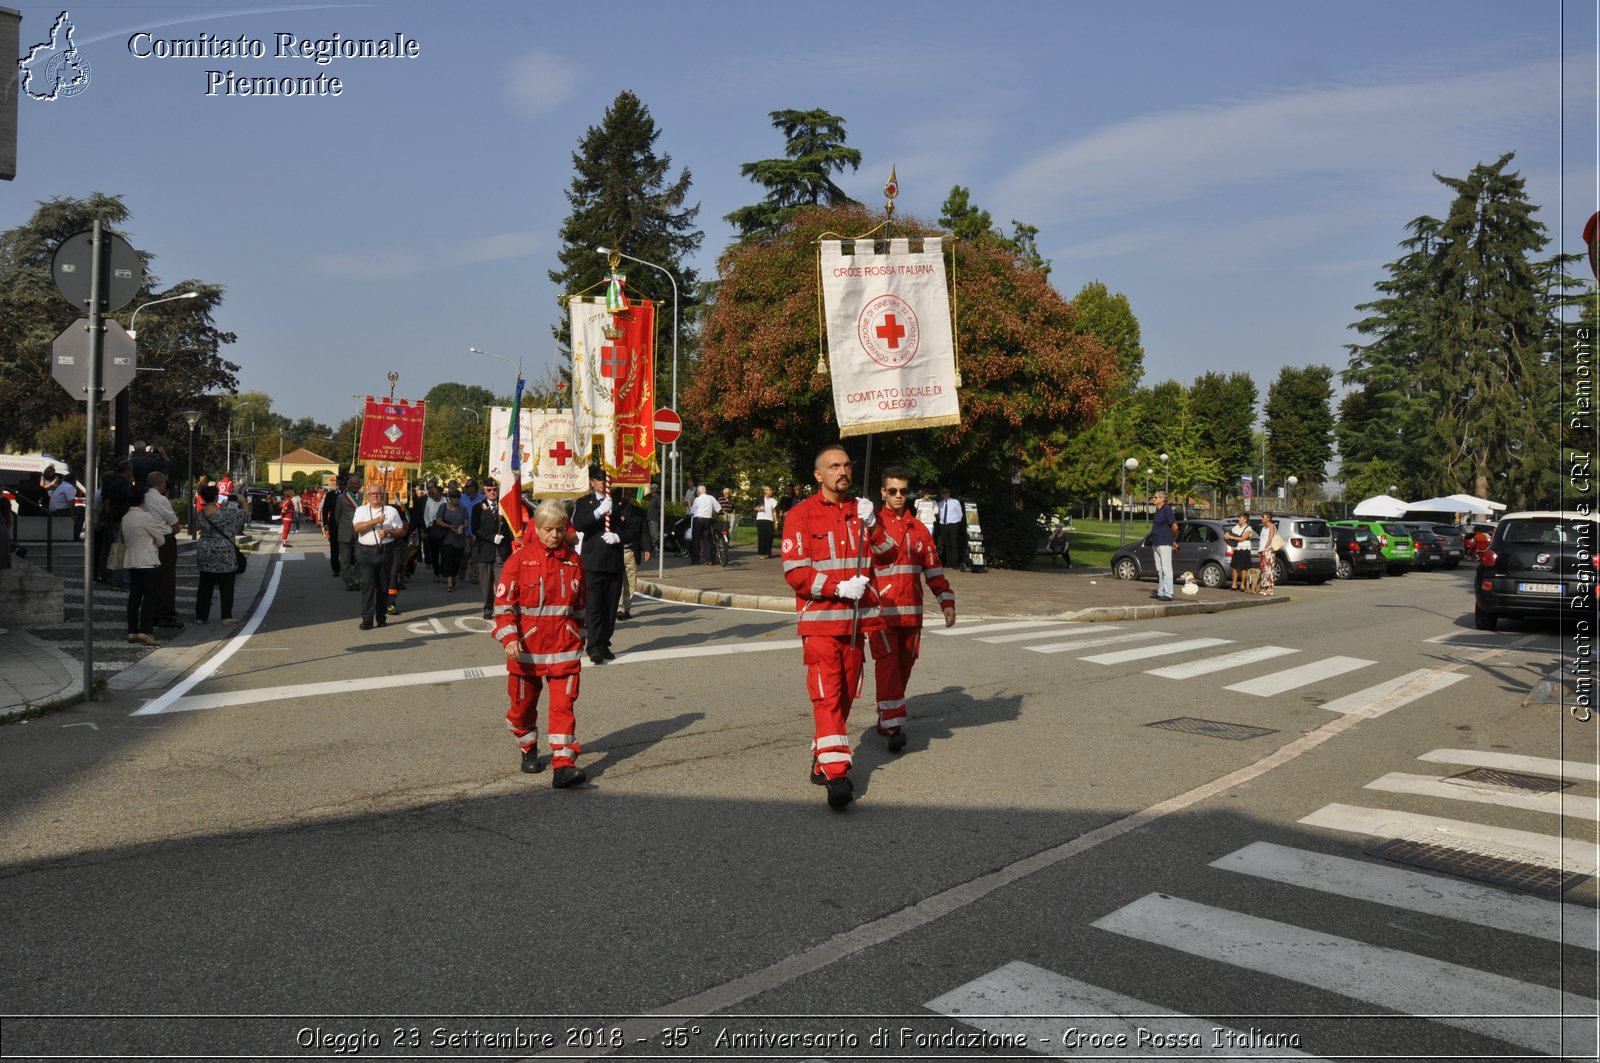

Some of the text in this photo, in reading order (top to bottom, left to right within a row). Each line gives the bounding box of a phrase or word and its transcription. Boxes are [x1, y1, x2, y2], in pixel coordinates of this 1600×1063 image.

[833, 264, 934, 278] CROCE ROSSA ITALIANA
[874, 299, 900, 311] GINEVRA
[846, 384, 943, 404] COMITATO LOCALE DI
[878, 398, 918, 411] OLEGGIO
